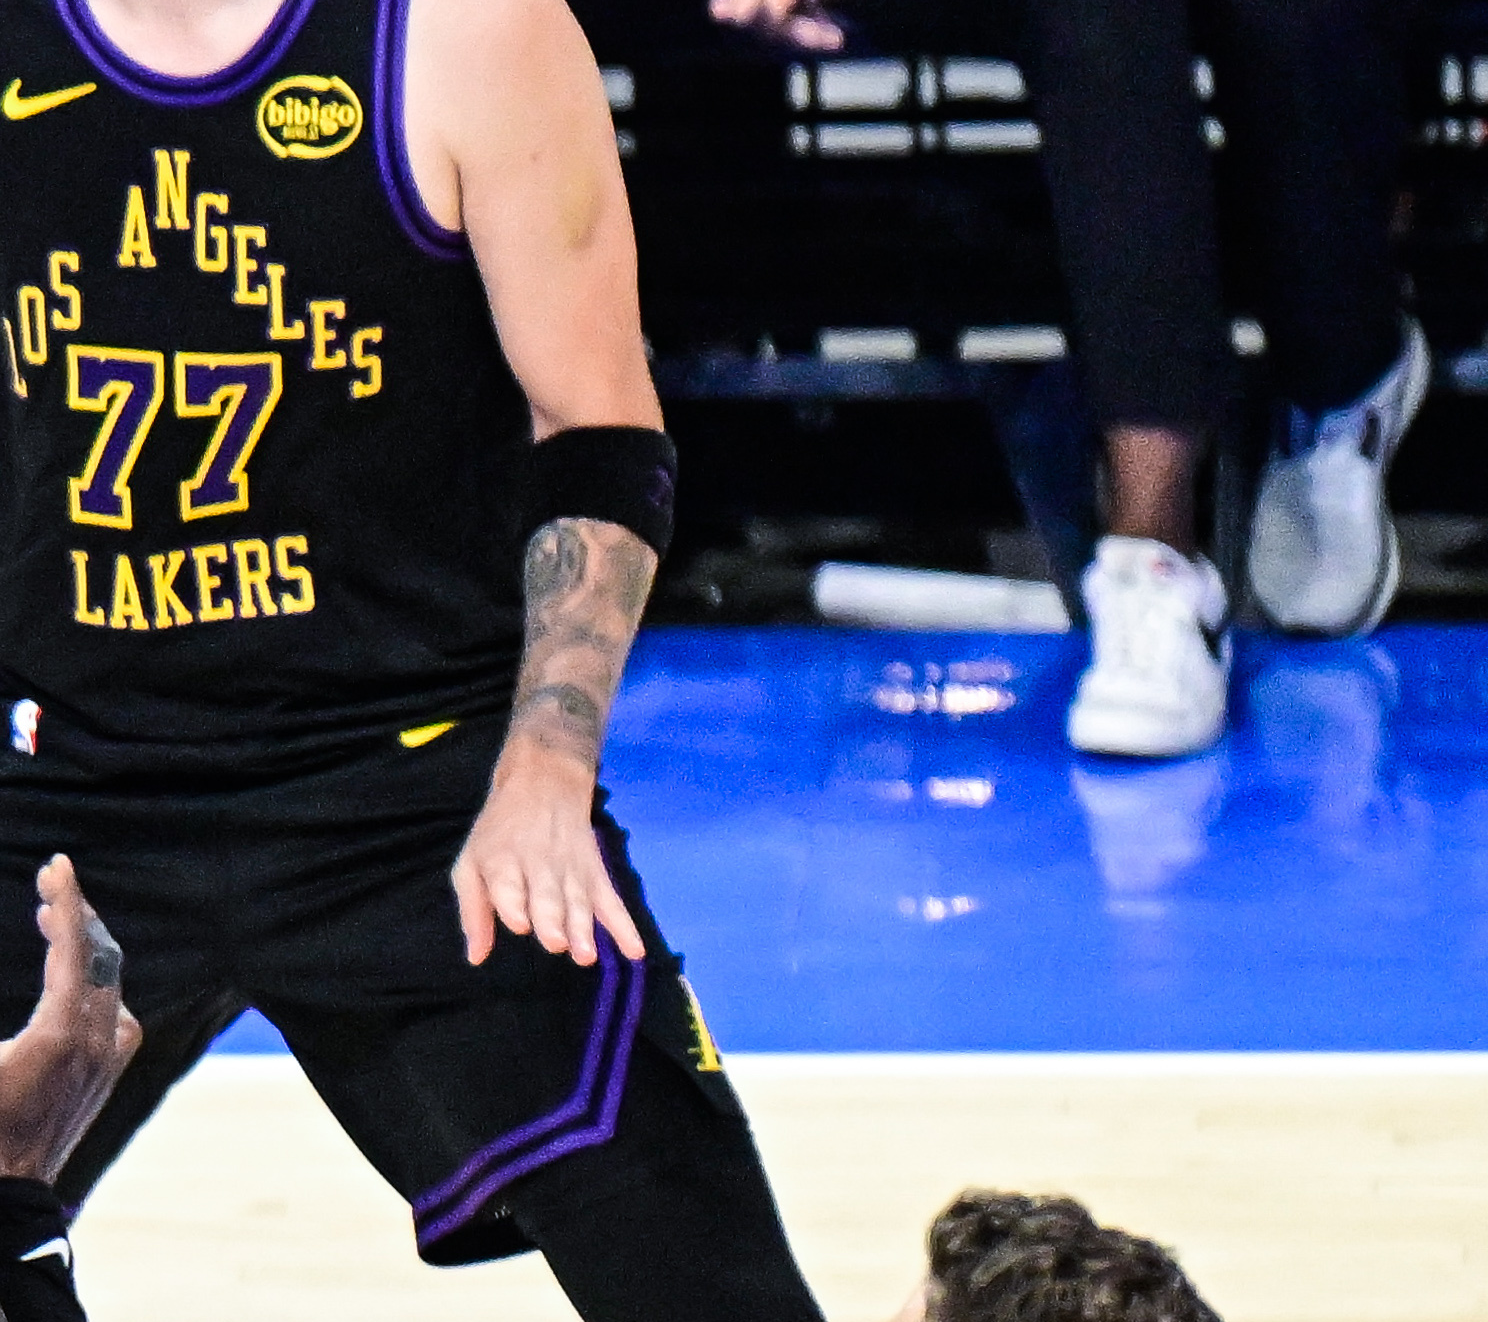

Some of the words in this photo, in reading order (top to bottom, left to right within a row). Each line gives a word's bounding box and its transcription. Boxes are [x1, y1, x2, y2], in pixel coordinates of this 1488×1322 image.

[267, 96, 356, 136] bibigo
[117, 148, 384, 399] ANGELES
[65, 343, 284, 530] 77
[70, 534, 317, 631] LAKERS
